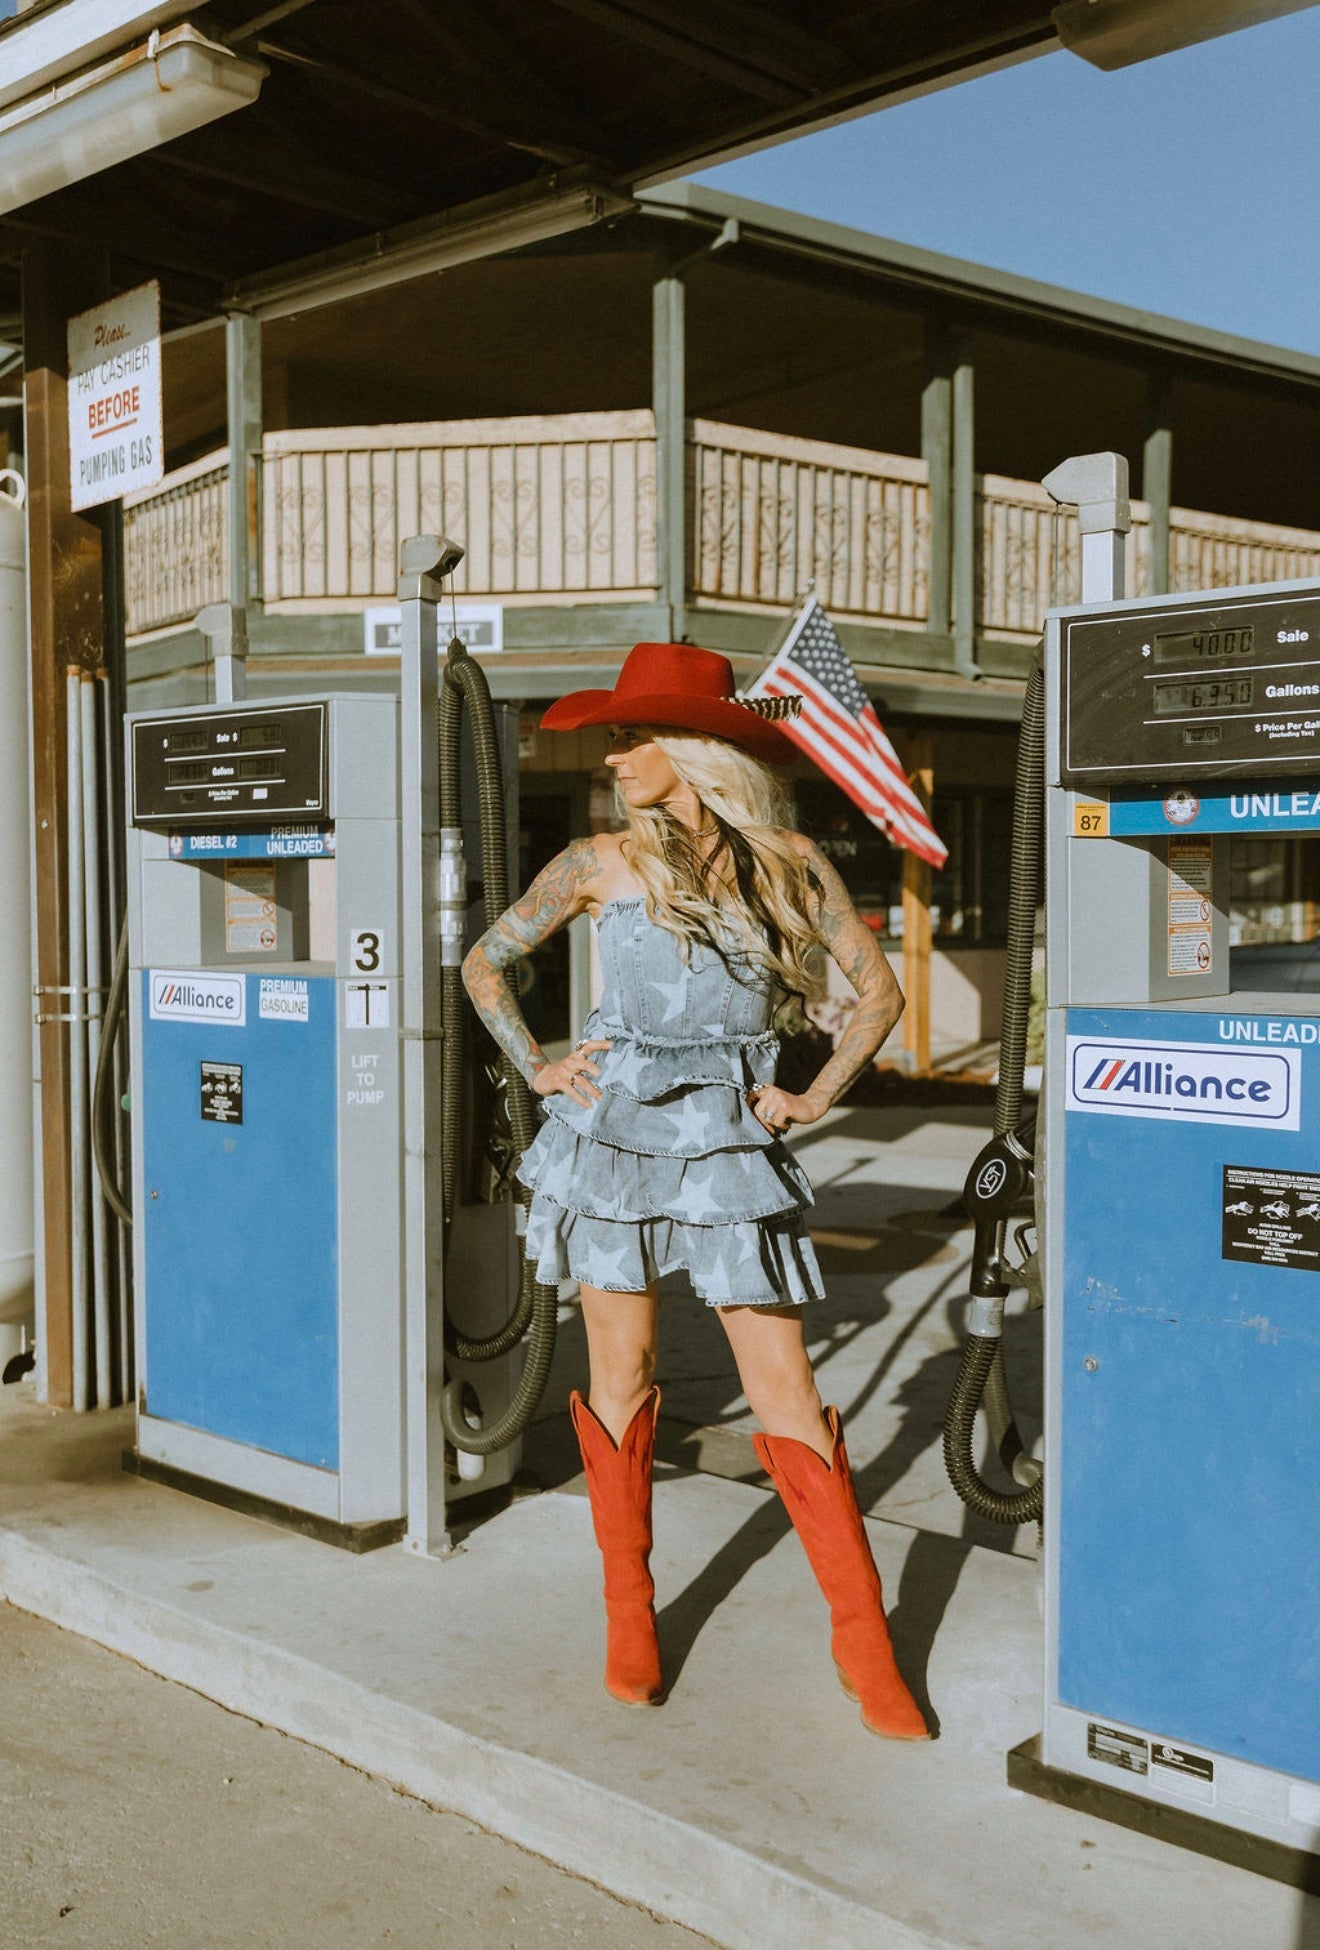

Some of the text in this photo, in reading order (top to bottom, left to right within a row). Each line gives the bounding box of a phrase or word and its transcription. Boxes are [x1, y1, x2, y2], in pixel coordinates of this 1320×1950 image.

[77, 344, 150, 395] PAY CASHIER
[88, 385, 140, 430] BEFORE
[80, 435, 153, 486] PUMPING GAS
[387, 624, 481, 646] MKET
[1276, 629, 1309, 644] Sale
[1142, 644, 1151, 657] $
[1192, 631, 1251, 656] 40.00
[1265, 683, 1320, 698] Gallons
[1262, 723, 1286, 732] Price
[1287, 722, 1302, 730] Per
[1079, 815, 1102, 831] 87
[270, 825, 319, 840] PREMIUM
[190, 836, 237, 849] DIESEL #2
[266, 839, 324, 855] UNLEADED
[354, 931, 380, 972] 3
[259, 978, 308, 995] PREMIUM
[172, 983, 235, 1010] Alliance
[261, 997, 308, 1015] GASOLINE
[1219, 1020, 1320, 1044] UNLEAD
[351, 1054, 380, 1069] LIFT
[356, 1072, 375, 1086] TO
[1113, 1060, 1272, 1103] Alliance
[346, 1090, 385, 1105] PUMP
[1247, 1227, 1259, 1235] DO
[1259, 1229, 1273, 1237] NOT
[1274, 1230, 1289, 1239] TOP
